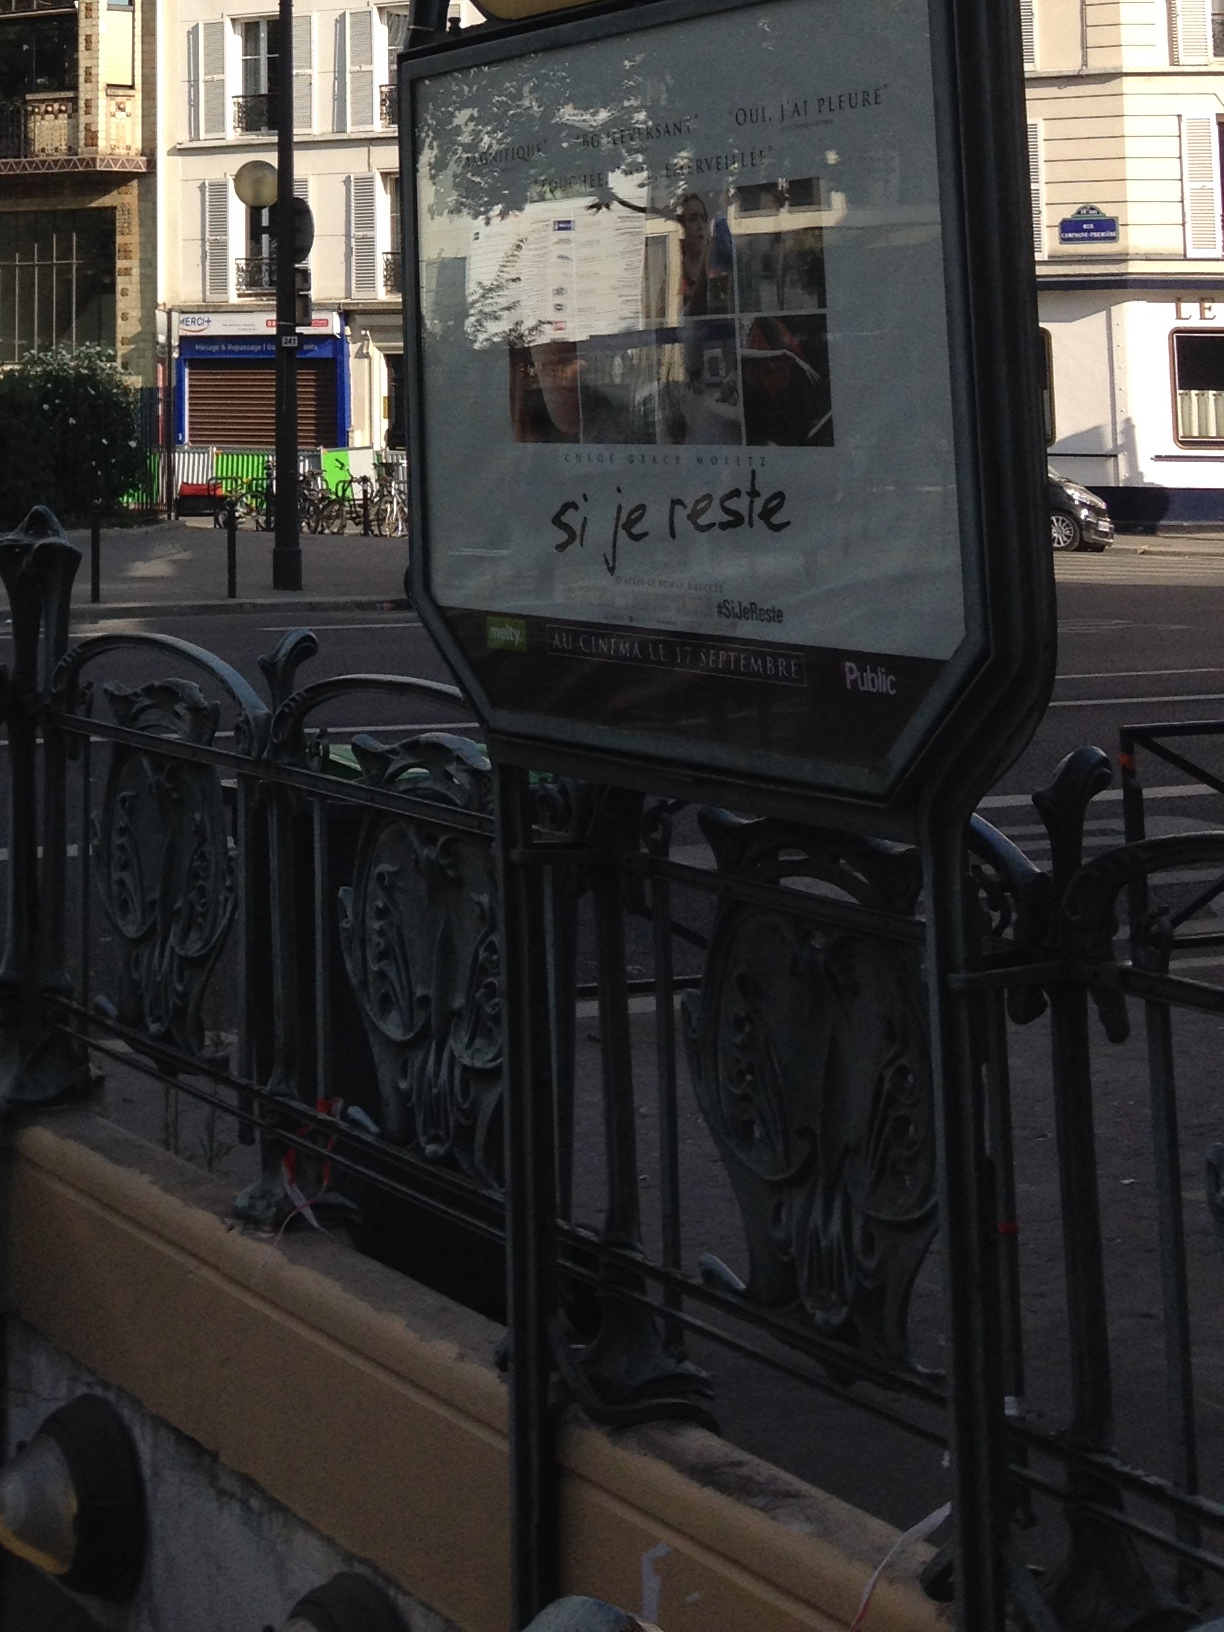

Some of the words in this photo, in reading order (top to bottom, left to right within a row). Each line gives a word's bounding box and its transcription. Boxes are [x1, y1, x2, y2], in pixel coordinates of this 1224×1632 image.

[1175, 297, 1216, 321] LE
[716, 598, 785, 624] #SiJeReste
[552, 632, 574, 651] AU
[649, 643, 668, 662] LE
[675, 646, 693, 664] 17
[699, 649, 799, 679] SEPTEMBRE
[844, 661, 897, 695] Public
